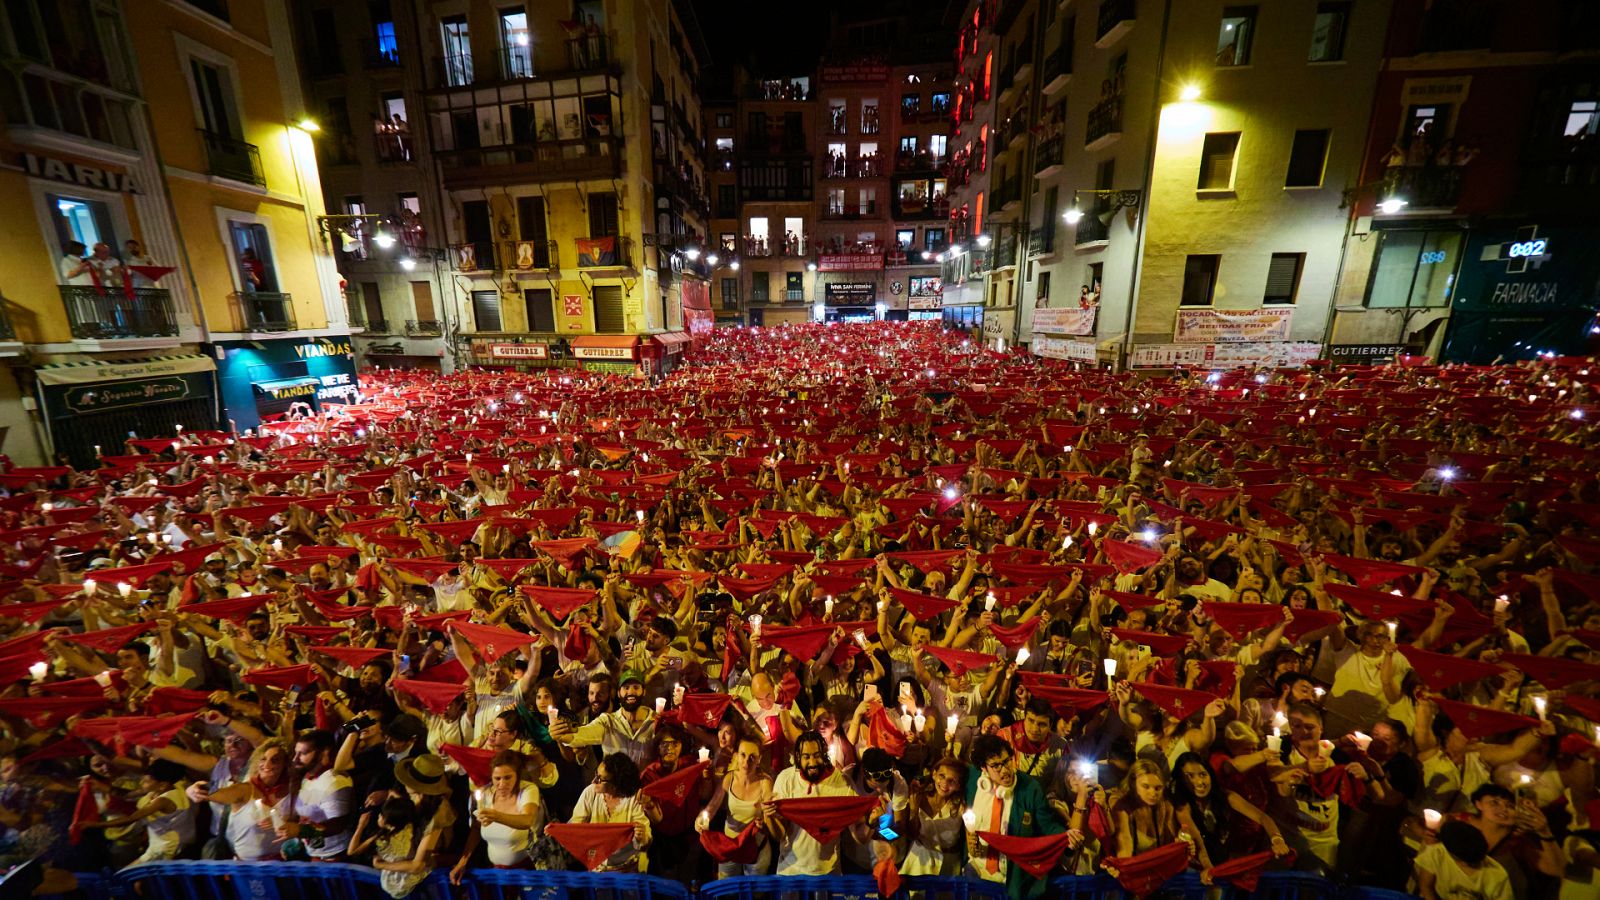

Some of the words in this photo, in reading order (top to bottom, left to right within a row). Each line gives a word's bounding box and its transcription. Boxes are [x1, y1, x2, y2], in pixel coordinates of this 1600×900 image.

[25, 152, 143, 195] IARIA
[1509, 240, 1546, 257] 0:02
[1492, 282, 1557, 303] FARMACIA
[294, 343, 351, 359] VIANDAS
[500, 347, 539, 355] GUTIERREZ
[583, 349, 624, 357] GUTIERREZ
[1332, 346, 1404, 356] GUTIERREZ
[271, 385, 315, 400] VIANDAS
